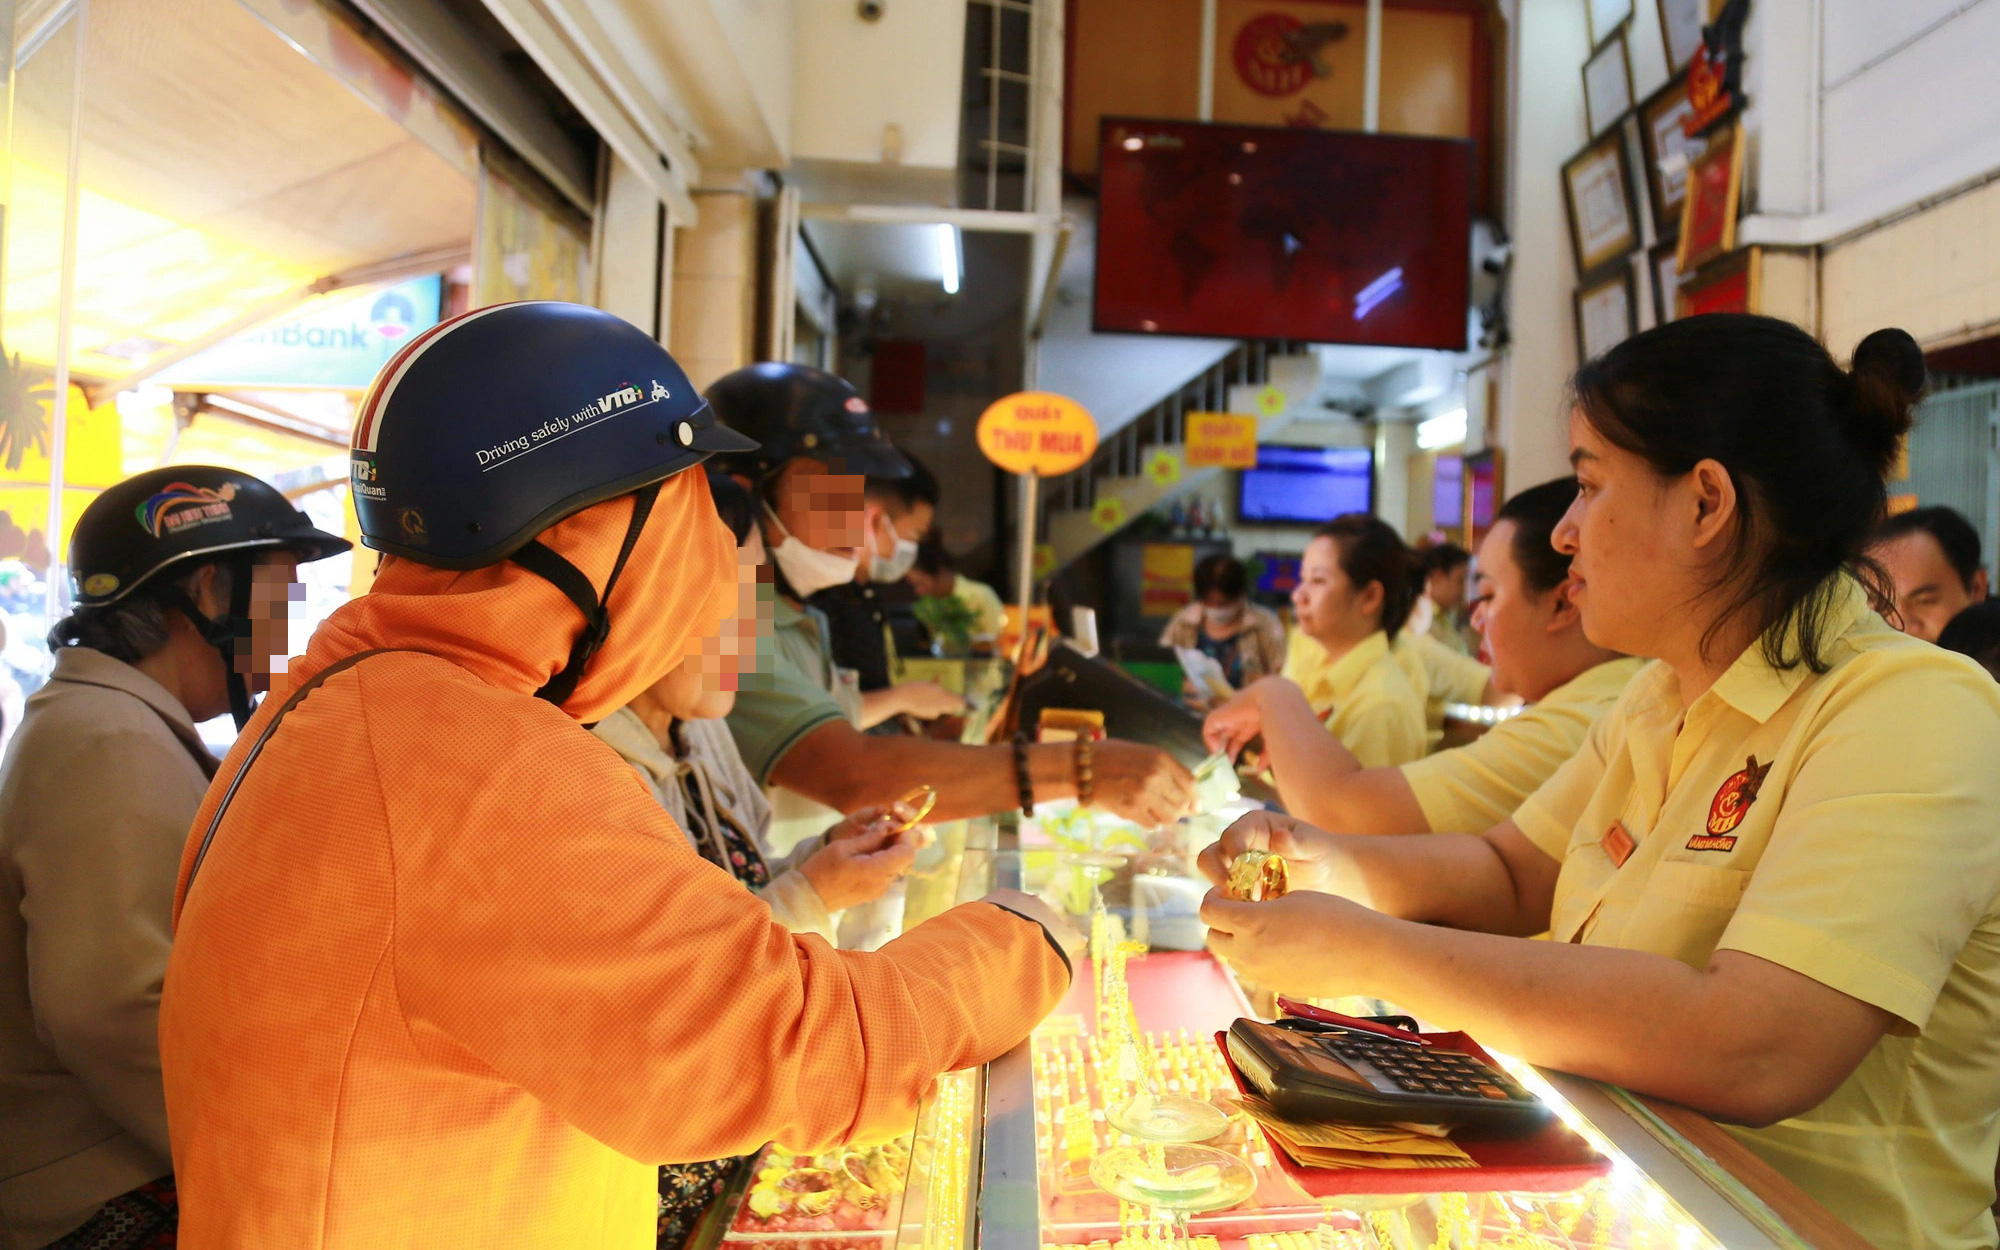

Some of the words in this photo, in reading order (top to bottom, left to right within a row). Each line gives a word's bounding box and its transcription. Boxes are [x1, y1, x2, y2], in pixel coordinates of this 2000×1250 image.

[475, 436, 530, 465] Driving
[531, 417, 570, 442] safely
[572, 403, 601, 423] with
[992, 428, 1033, 452] THU
[1040, 430, 1083, 454] MUA
